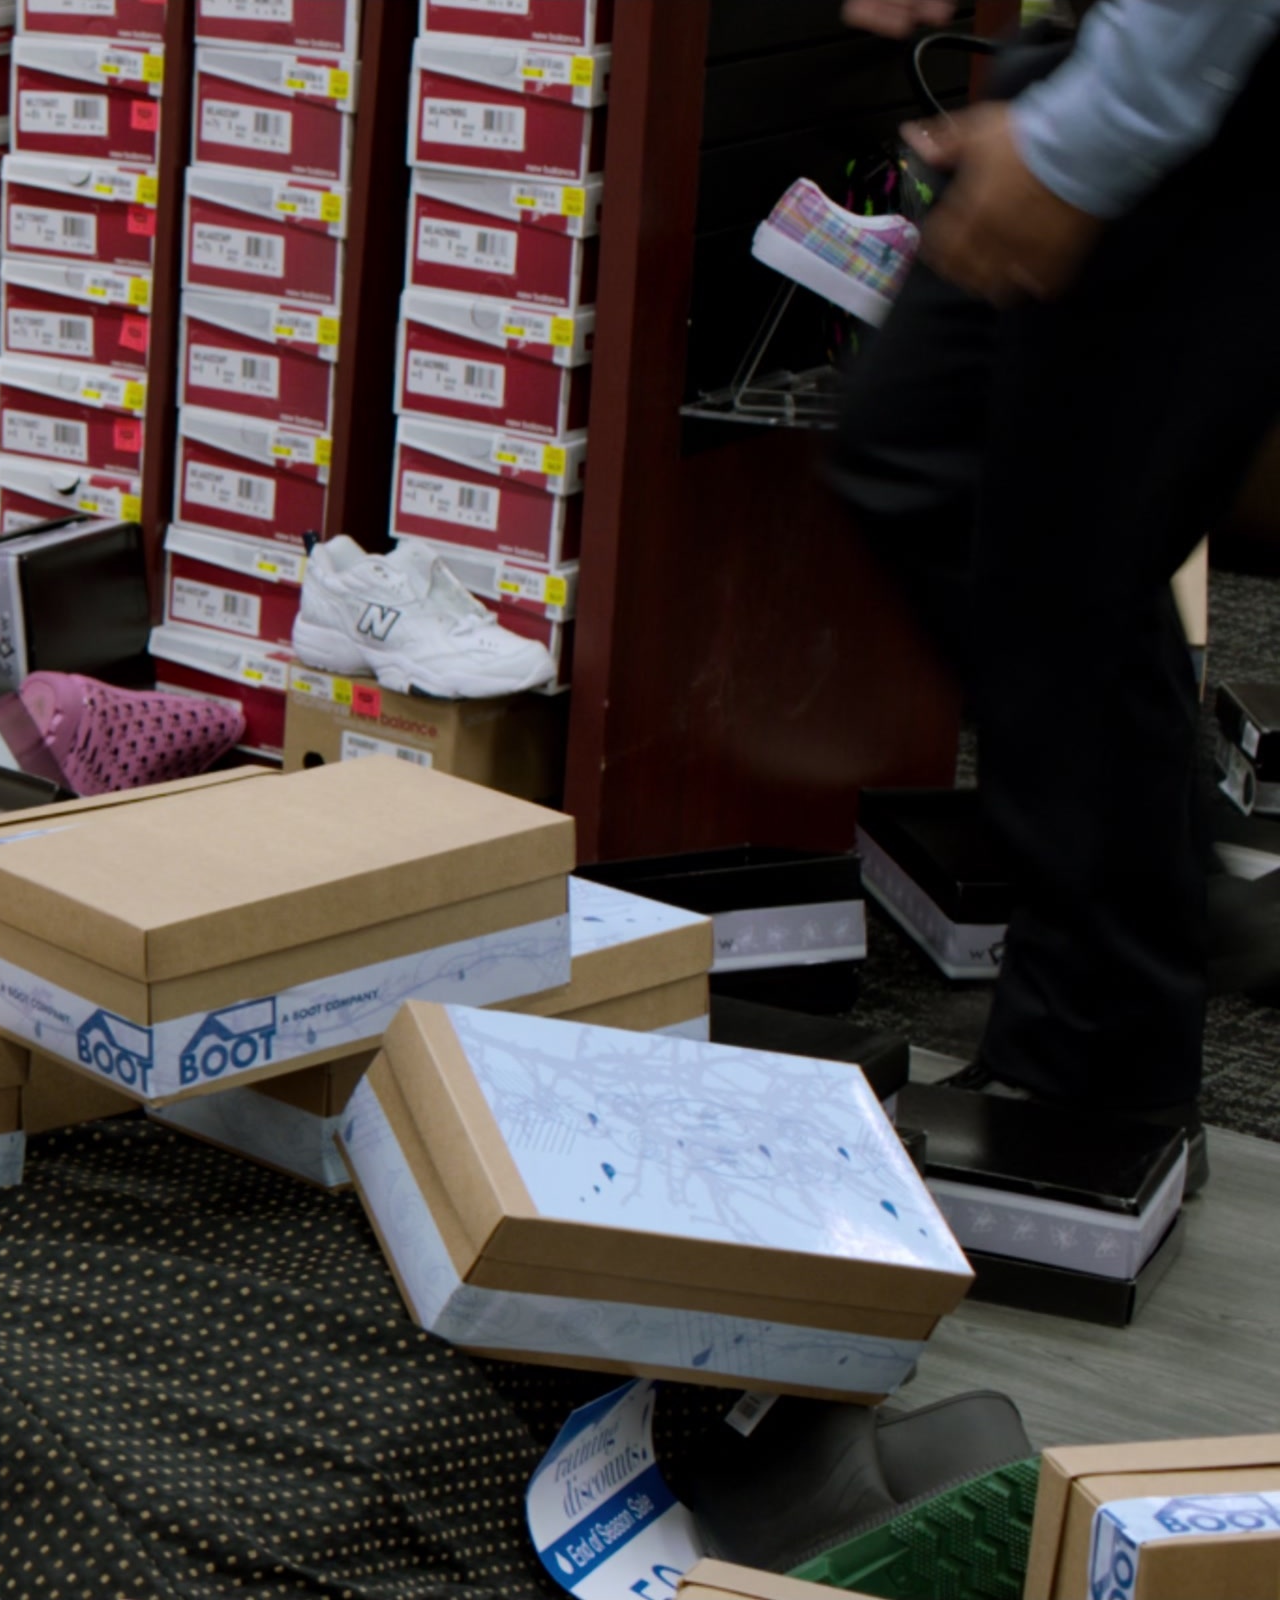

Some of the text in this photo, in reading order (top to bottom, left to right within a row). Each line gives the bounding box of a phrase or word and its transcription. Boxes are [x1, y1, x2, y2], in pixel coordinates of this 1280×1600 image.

[357, 603, 400, 641] N
[292, 1003, 323, 1023] BOOT
[325, 989, 380, 1016] COMPANY
[77, 1034, 152, 1093] BOOT
[179, 1030, 277, 1086] BOOT
[589, 1527, 606, 1553] of
[595, 1509, 636, 1545] Season
[566, 1537, 595, 1567] End
